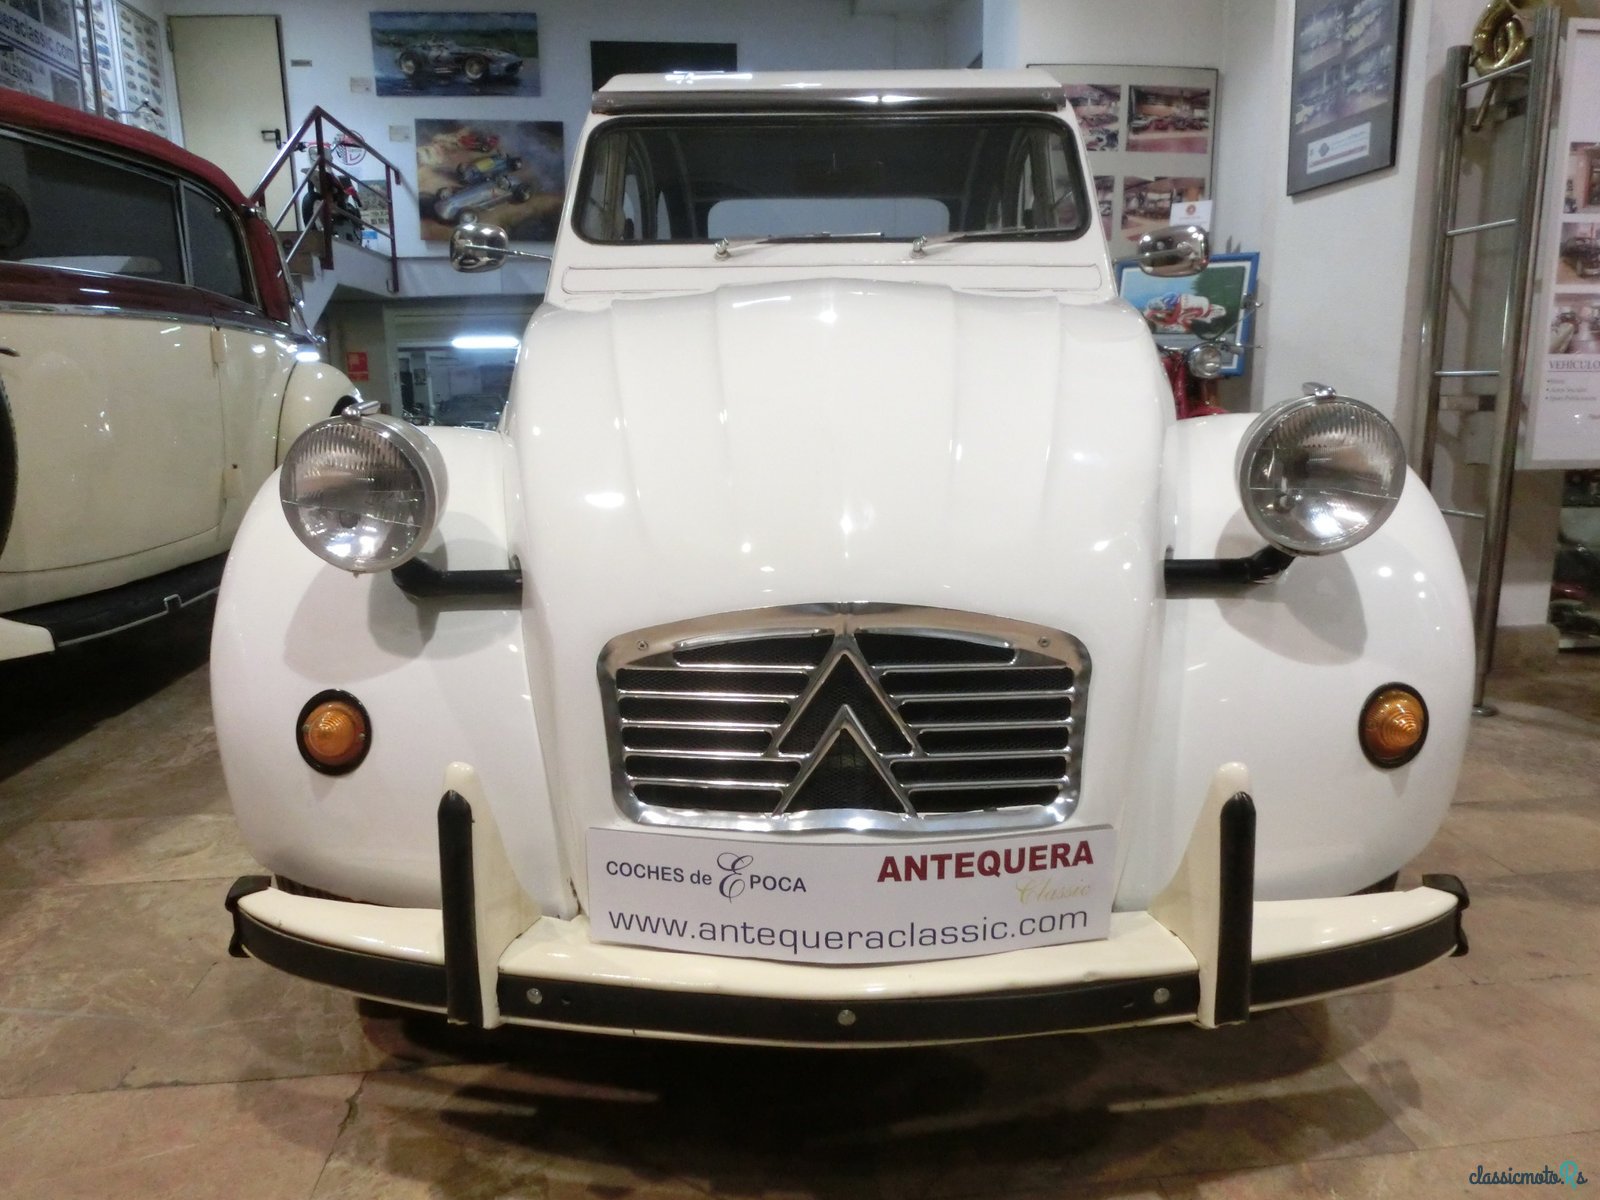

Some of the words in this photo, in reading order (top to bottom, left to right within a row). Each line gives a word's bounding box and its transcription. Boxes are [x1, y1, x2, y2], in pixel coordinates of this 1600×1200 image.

[606, 860, 685, 883] COCHES
[690, 869, 713, 886] de
[876, 840, 1094, 883] ANTEQUERA
[1015, 876, 1091, 905] Classic
[608, 910, 1088, 955] www.antequeraclassic.com
